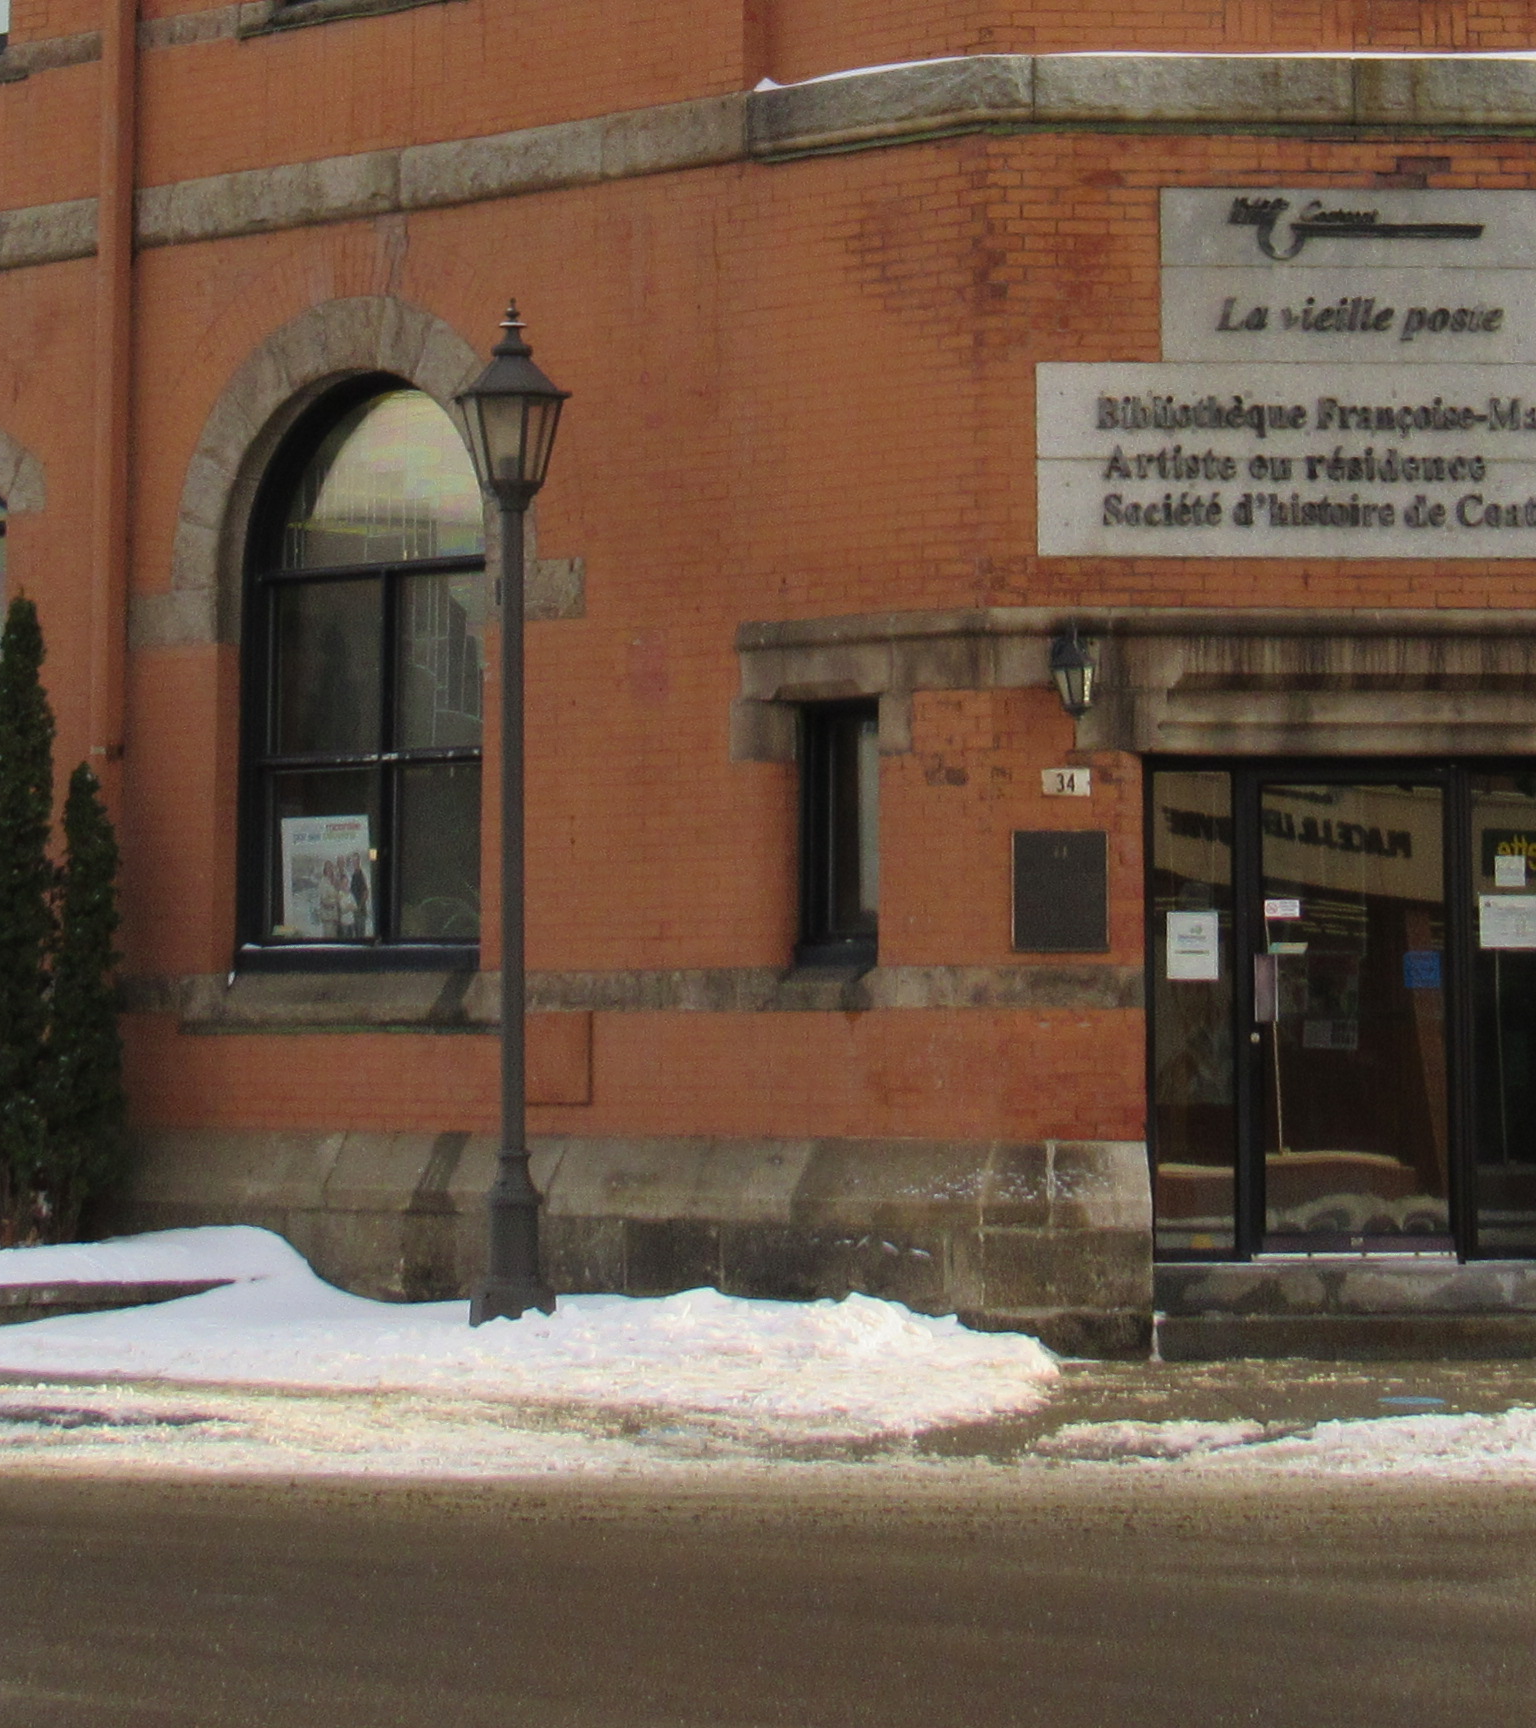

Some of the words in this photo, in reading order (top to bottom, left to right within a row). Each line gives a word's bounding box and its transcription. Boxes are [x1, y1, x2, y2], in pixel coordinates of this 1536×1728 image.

[1215, 297, 1269, 332] La
[1280, 295, 1395, 332] vieille
[1400, 303, 1504, 342] poste
[1096, 395, 1307, 439] Bibliothèque
[1102, 444, 1237, 481] Artiste
[1248, 454, 1293, 482] en
[1305, 445, 1486, 483] résidence
[1102, 492, 1222, 528] Société
[1233, 492, 1395, 528] d'histoire
[1404, 493, 1446, 528] de
[1057, 773, 1075, 793] 34
